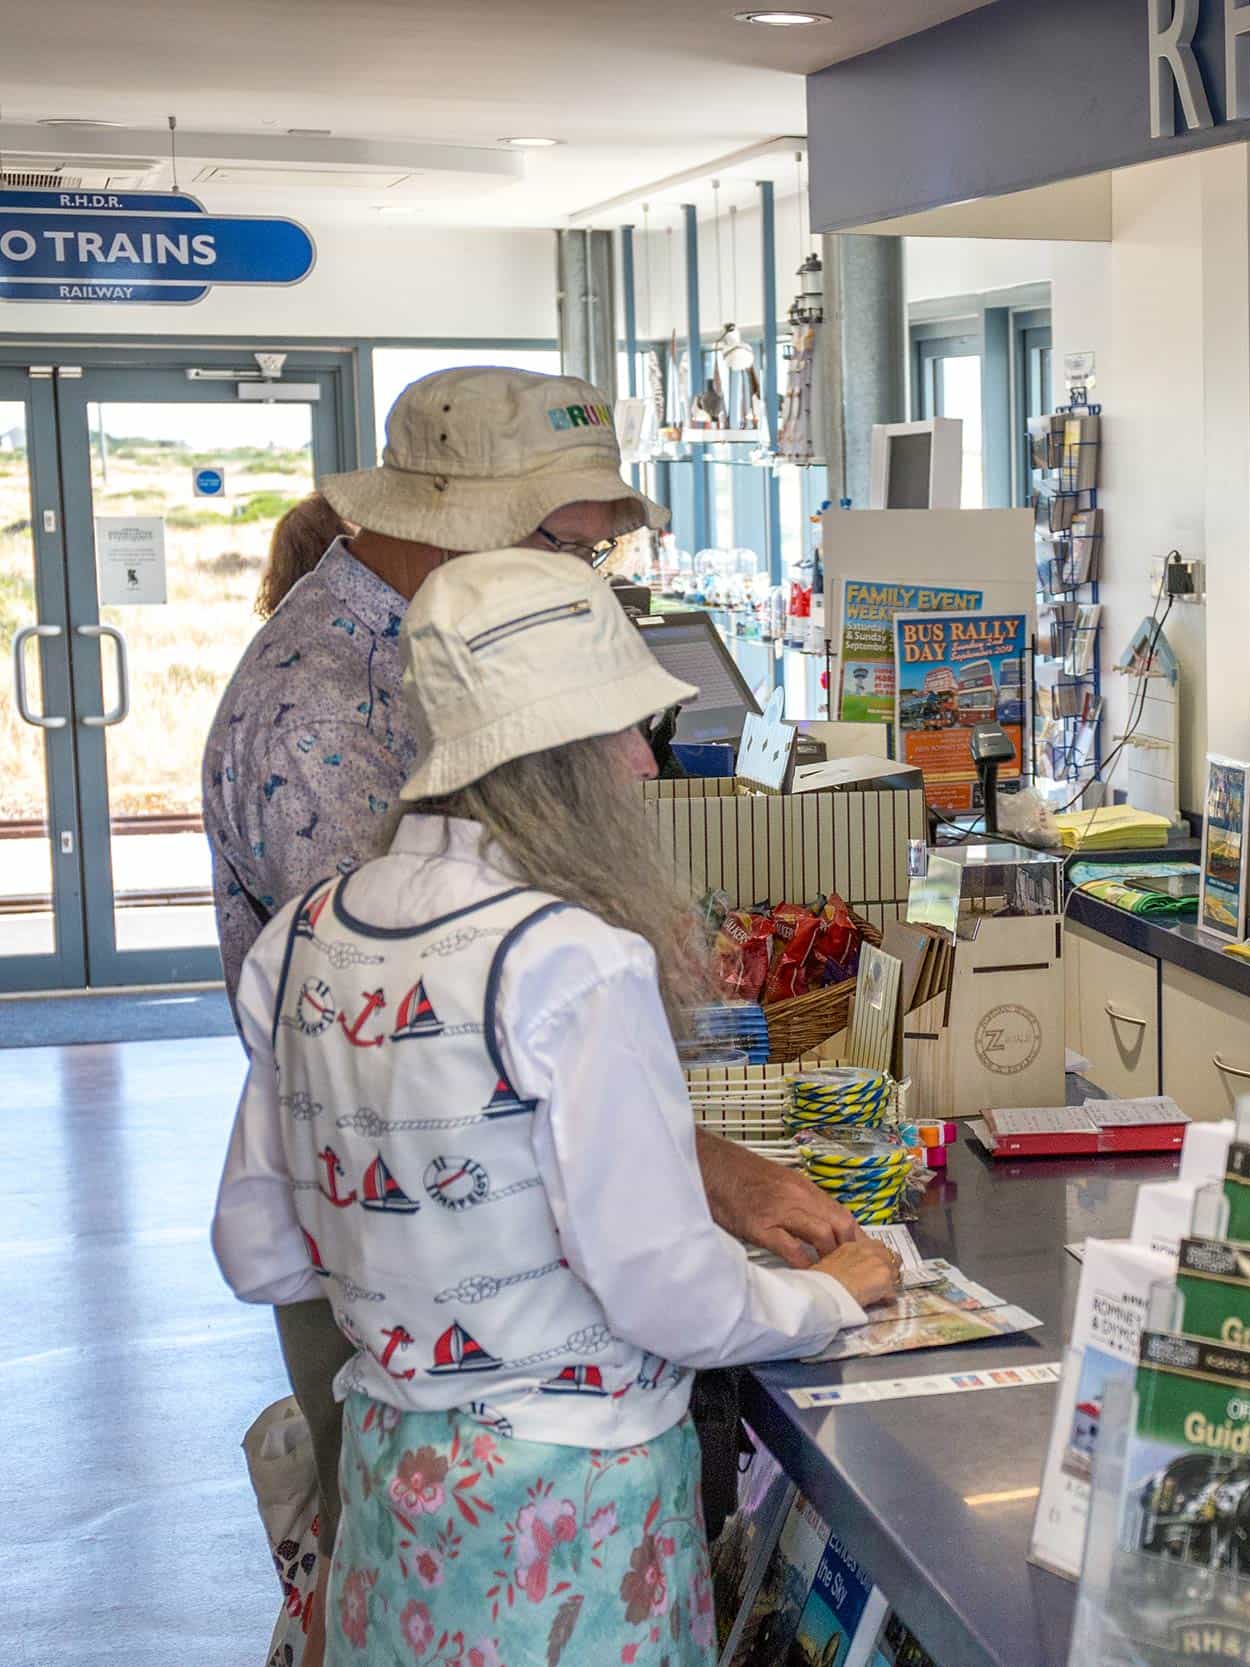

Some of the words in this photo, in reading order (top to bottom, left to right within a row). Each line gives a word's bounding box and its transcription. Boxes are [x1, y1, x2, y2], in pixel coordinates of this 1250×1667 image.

[59, 195, 123, 208] R.H.D.R.
[0, 230, 36, 262] O
[43, 231, 217, 265] TRAINS
[59, 286, 134, 299] RAILWAY
[847, 585, 915, 609] FAMILY
[918, 590, 980, 611] EVENT
[846, 631, 853, 640] &
[855, 631, 887, 644] Sunday
[904, 623, 944, 643] BUS
[951, 620, 1019, 640] RALLY
[845, 641, 887, 652] September
[904, 643, 946, 663] DAY
[817, 1558, 833, 1587] the
[831, 1572, 848, 1611] Sky
